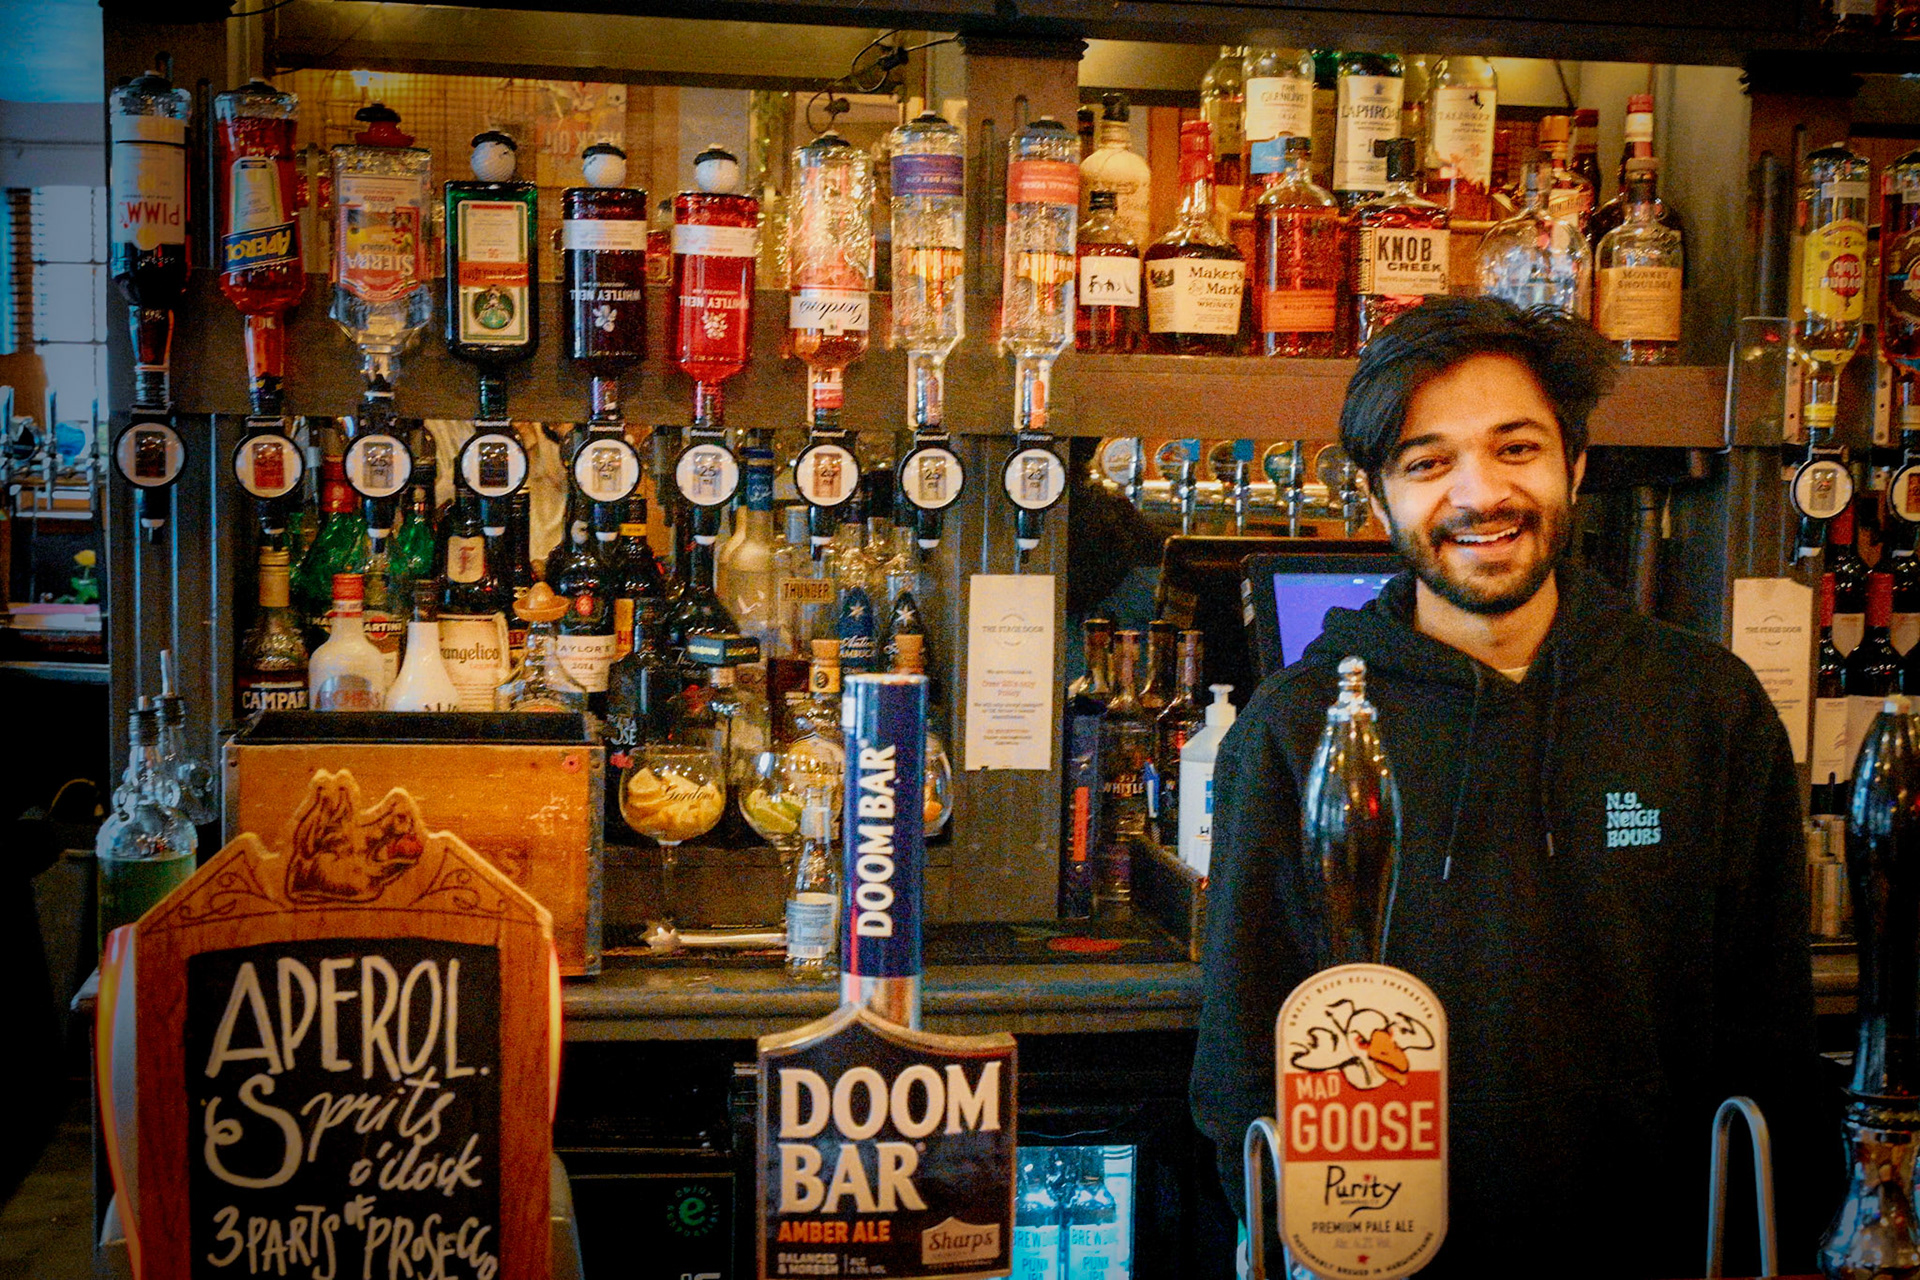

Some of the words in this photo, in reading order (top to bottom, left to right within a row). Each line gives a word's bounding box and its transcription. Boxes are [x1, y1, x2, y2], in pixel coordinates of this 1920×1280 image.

[225, 230, 291, 261] APEROL
[1377, 236, 1432, 262] KNOB
[346, 254, 414, 276] SIERRA
[1189, 266, 1244, 281] Maker's
[1387, 262, 1442, 272] CREEK
[569, 289, 595, 301] NEILL
[598, 289, 641, 301] WHITLEY
[1206, 282, 1241, 295] Mark
[679, 295, 705, 308] NEILL
[708, 297, 750, 309] WHITLEY
[700, 466, 716, 477] 25
[784, 583, 830, 600] THUNDER
[364, 622, 403, 634] ARTINI
[441, 642, 499, 664] rangelico
[560, 645, 611, 654] AYLOR'S
[242, 690, 310, 710] CAMPAR
[858, 744, 896, 818] BAR
[1607, 827, 1662, 848] BOURS
[856, 825, 895, 937] DOOM
[1296, 1075, 1341, 1101] MAD
[779, 1061, 1002, 1139] DOOM
[1291, 1101, 1436, 1153] GOOSE
[779, 1143, 927, 1214] BAR
[1324, 1165, 1402, 1218] Purity
[778, 1221, 849, 1243] AMBER
[852, 1220, 892, 1243] ALE
[1312, 1221, 1362, 1234] PREMIUM
[1366, 1220, 1390, 1233] PALE
[1395, 1219, 1414, 1232] ALE
[207, 1205, 244, 1268] 3
[247, 1205, 341, 1280] PARTS
[344, 1194, 377, 1231] OF
[363, 1213, 499, 1280] PROSECCO
[778, 1253, 838, 1264] BALANCED
